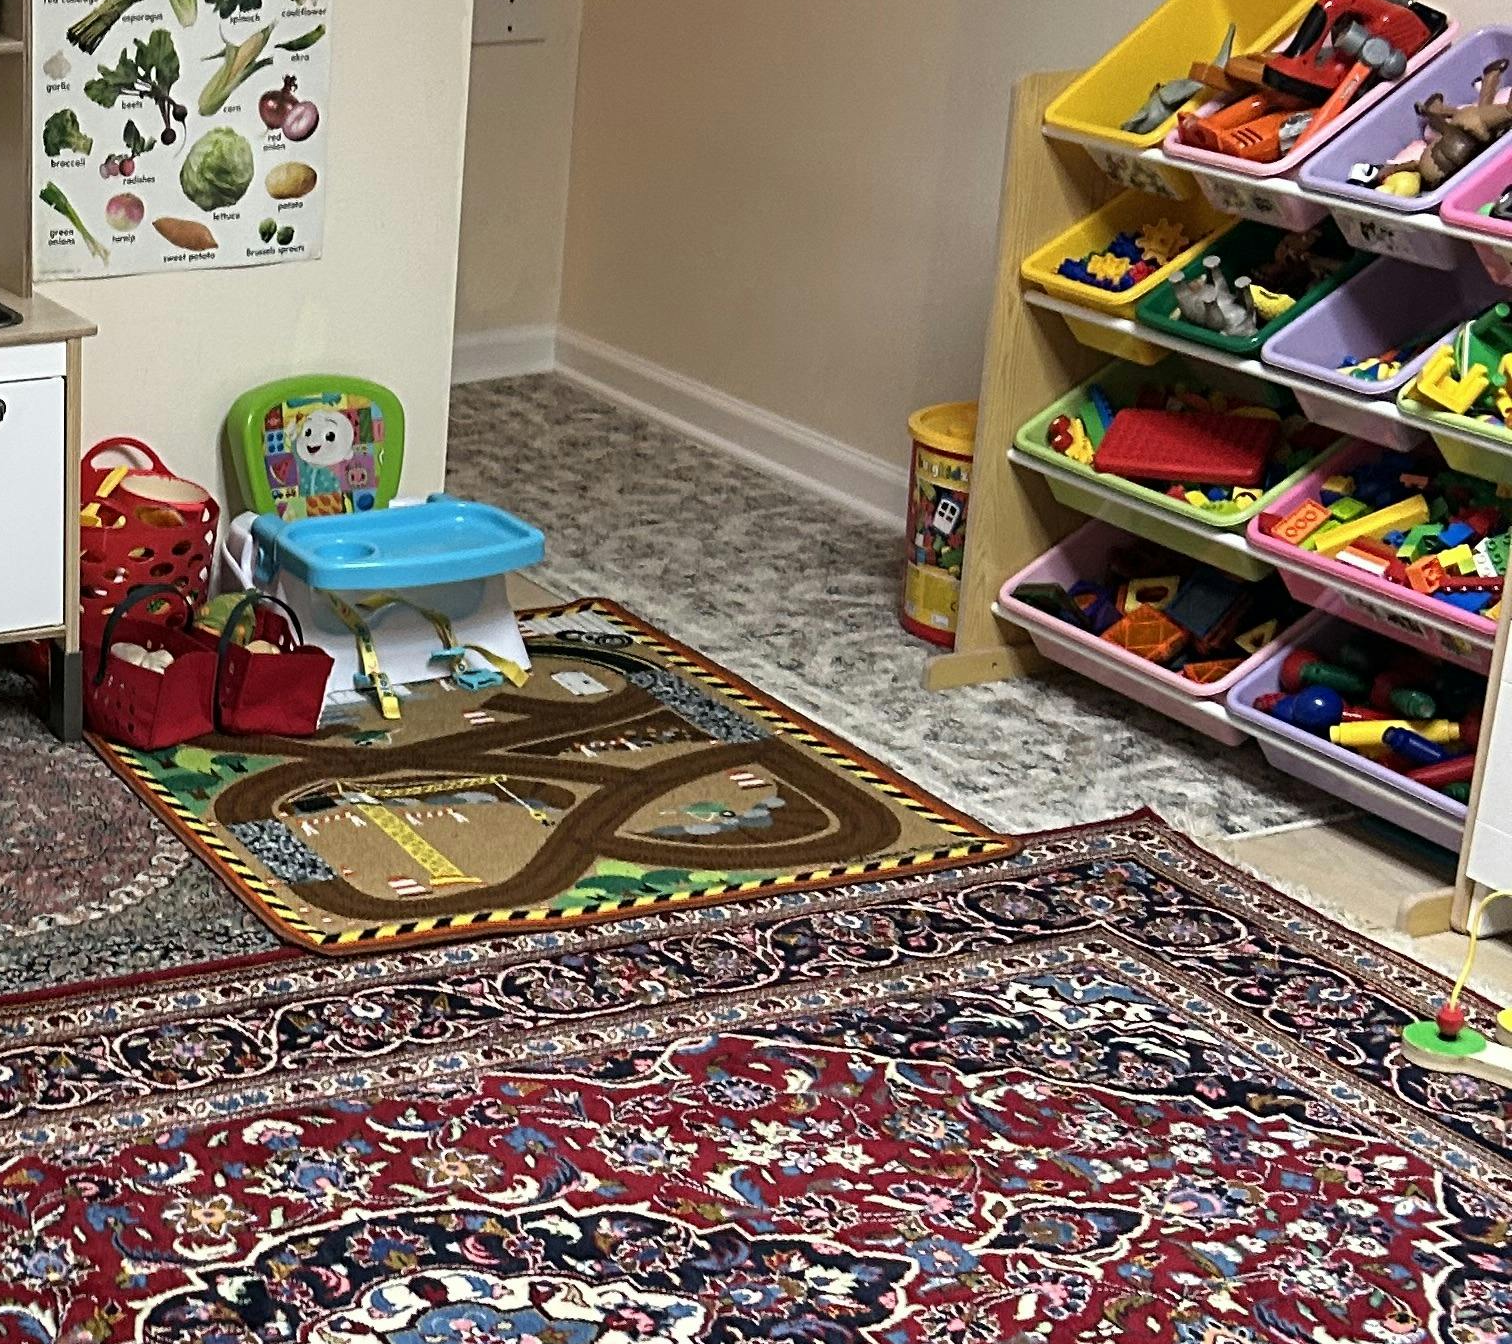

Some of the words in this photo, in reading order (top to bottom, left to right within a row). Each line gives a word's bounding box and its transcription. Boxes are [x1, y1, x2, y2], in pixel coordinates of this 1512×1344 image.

[46, 81, 70, 93] garlic
[121, 100, 143, 109] beets
[50, 158, 86, 167] broccoli
